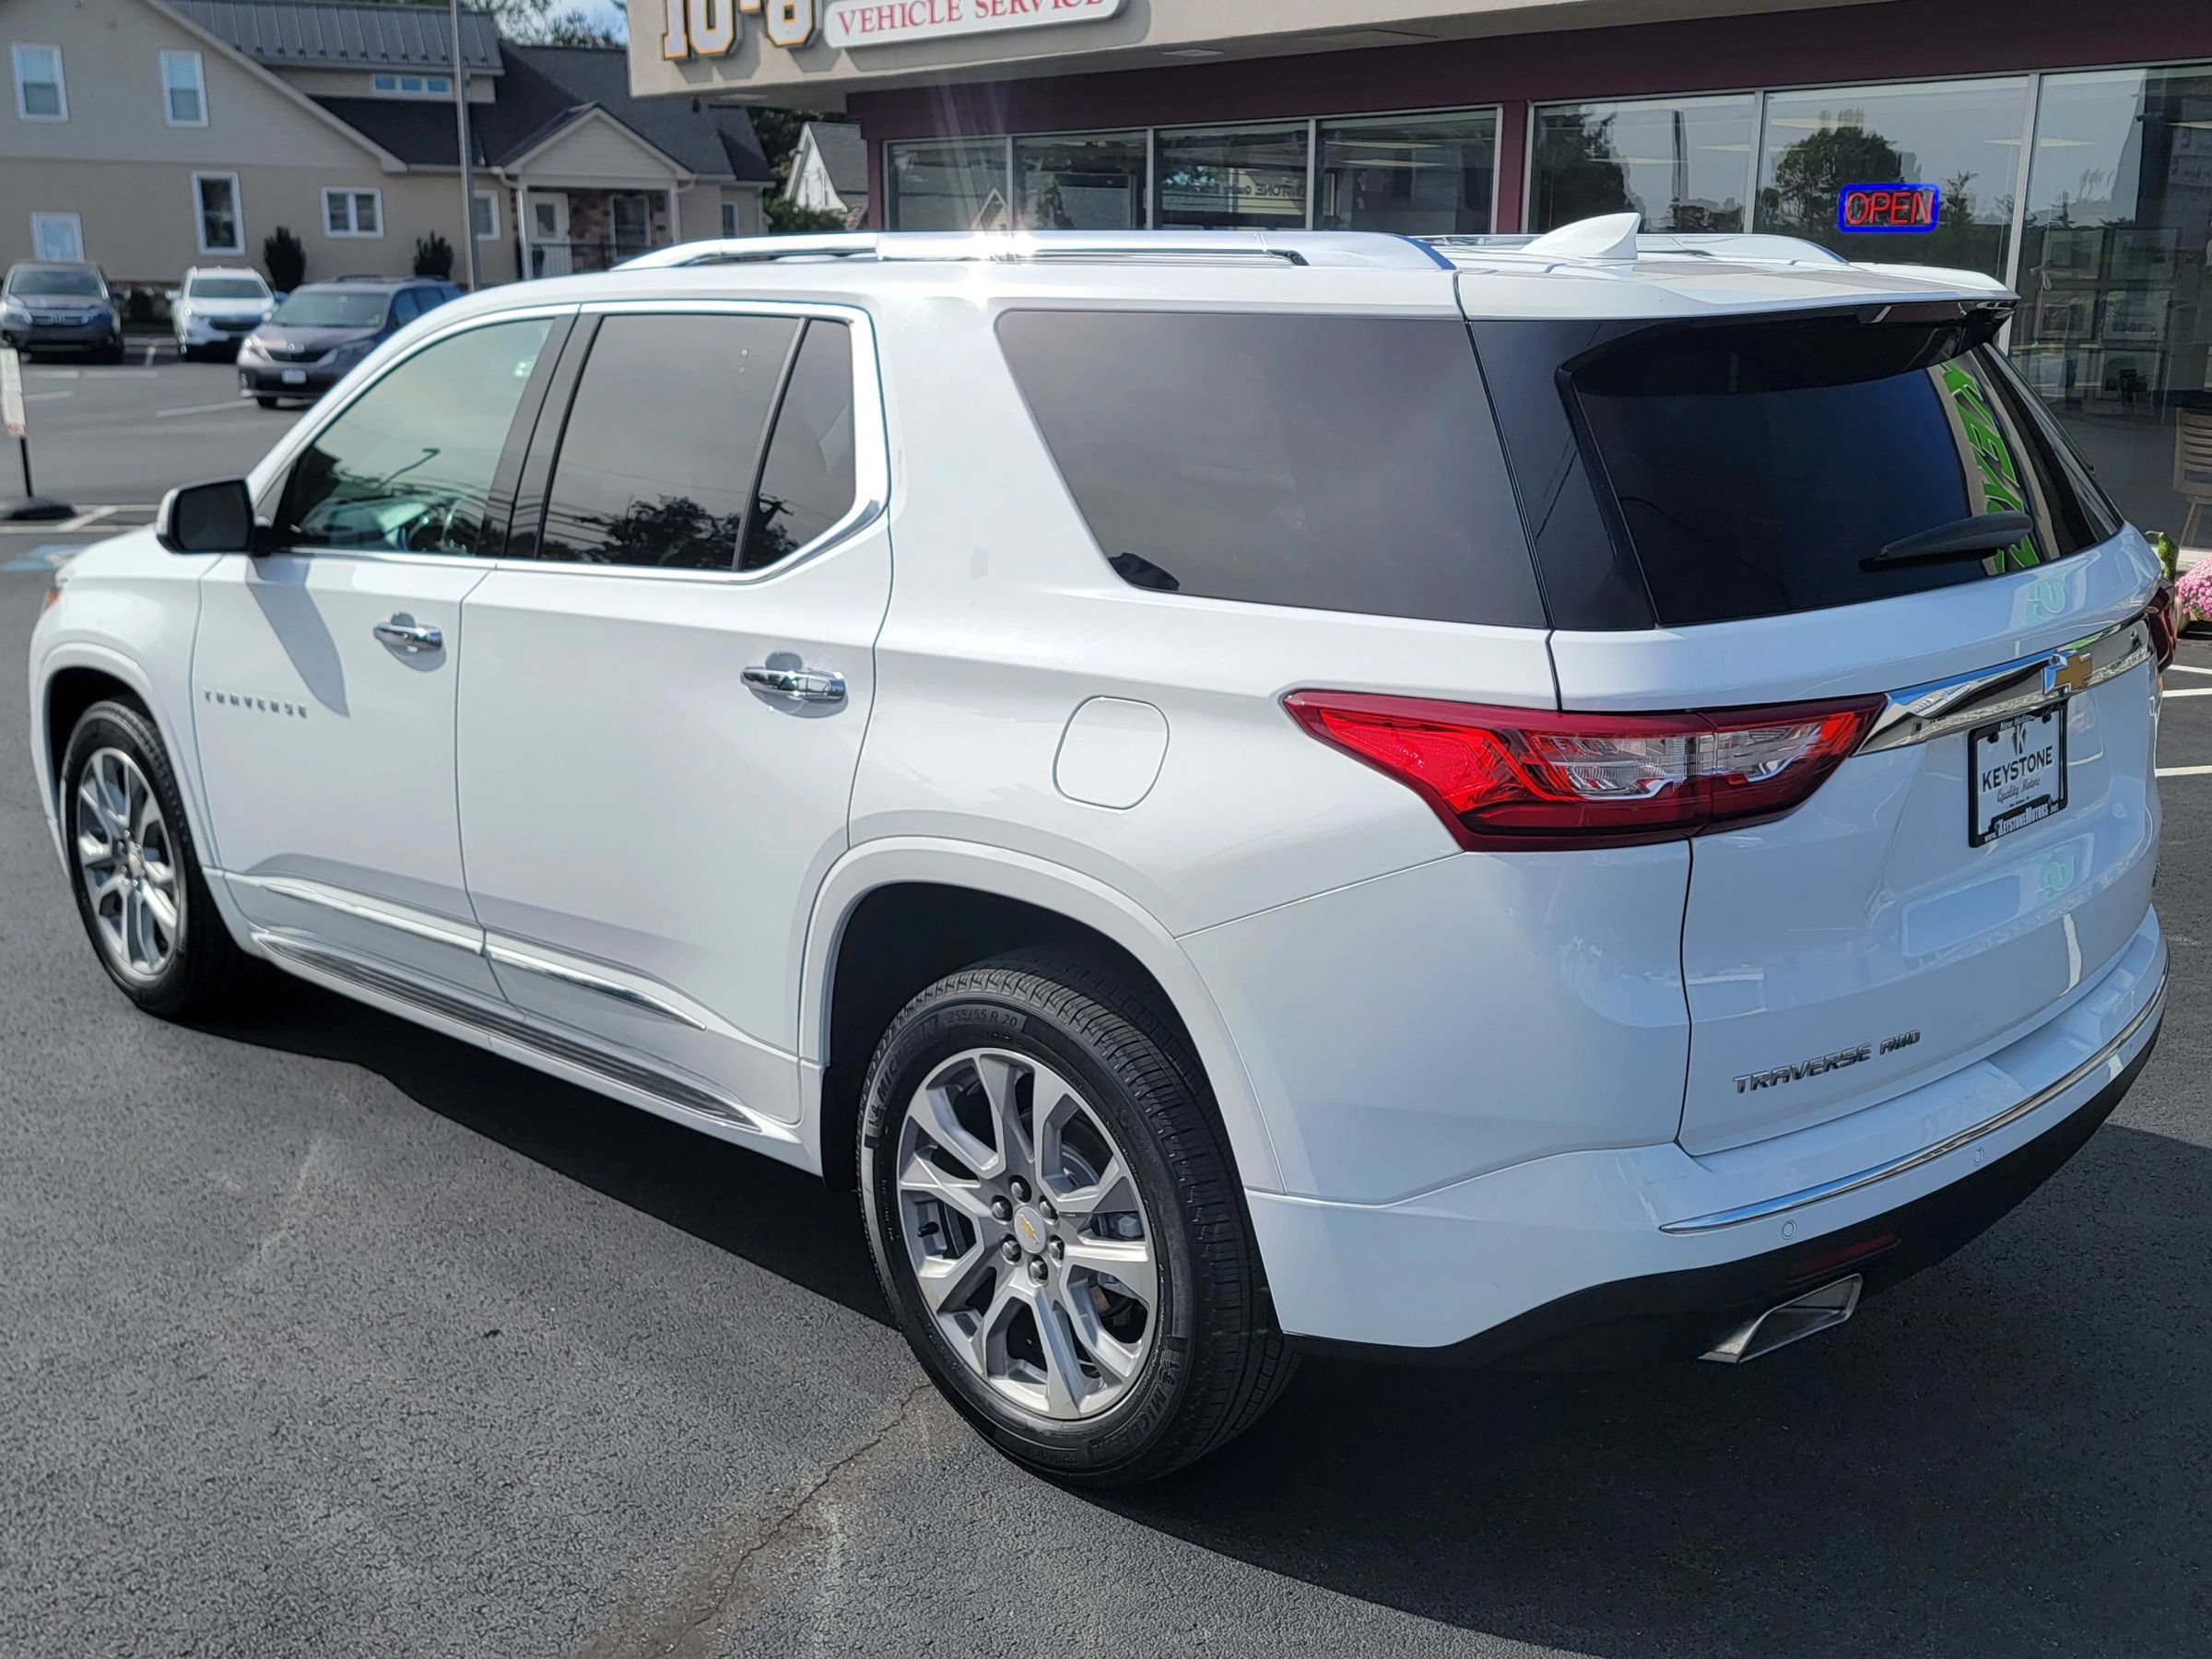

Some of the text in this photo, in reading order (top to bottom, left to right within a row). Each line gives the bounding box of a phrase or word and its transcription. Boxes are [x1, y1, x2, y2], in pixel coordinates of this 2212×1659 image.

[838, 0, 1105, 36] VEHICLE SERV
[1844, 192, 1934, 225] OPEN
[1982, 746, 2053, 793] KEYSTONE
[1733, 1030, 1922, 1094] TRAVERSE AWD
